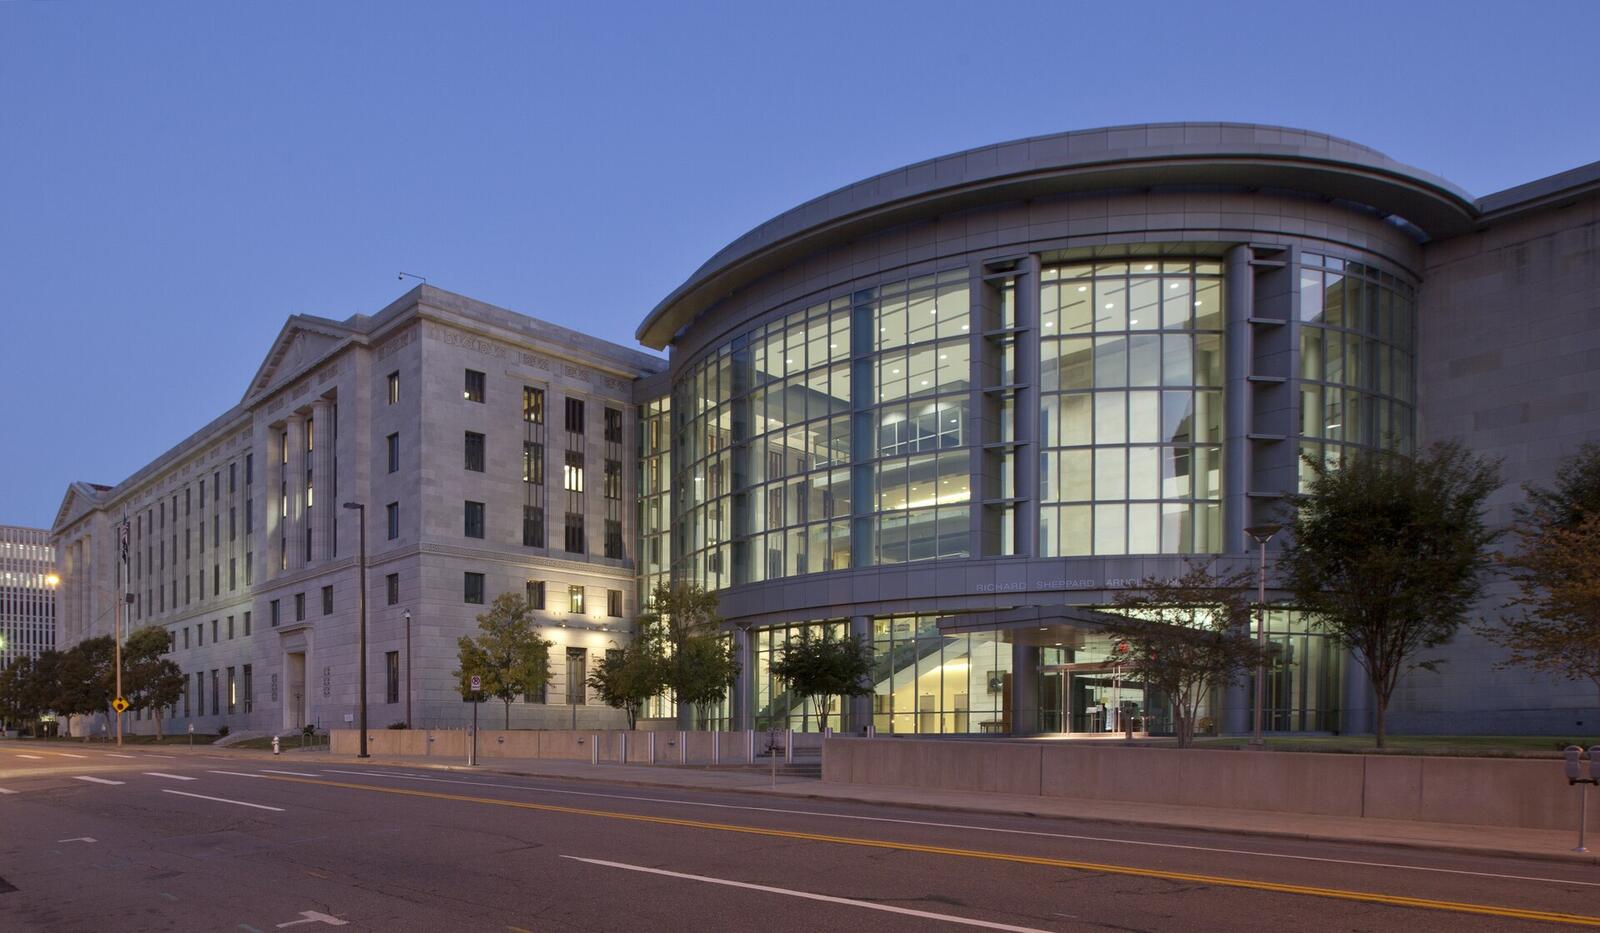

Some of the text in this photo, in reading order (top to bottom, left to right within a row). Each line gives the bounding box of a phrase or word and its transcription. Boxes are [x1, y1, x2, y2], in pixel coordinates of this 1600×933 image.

[976, 577, 1144, 592] RICHARD SHEPPARD ARNOL
